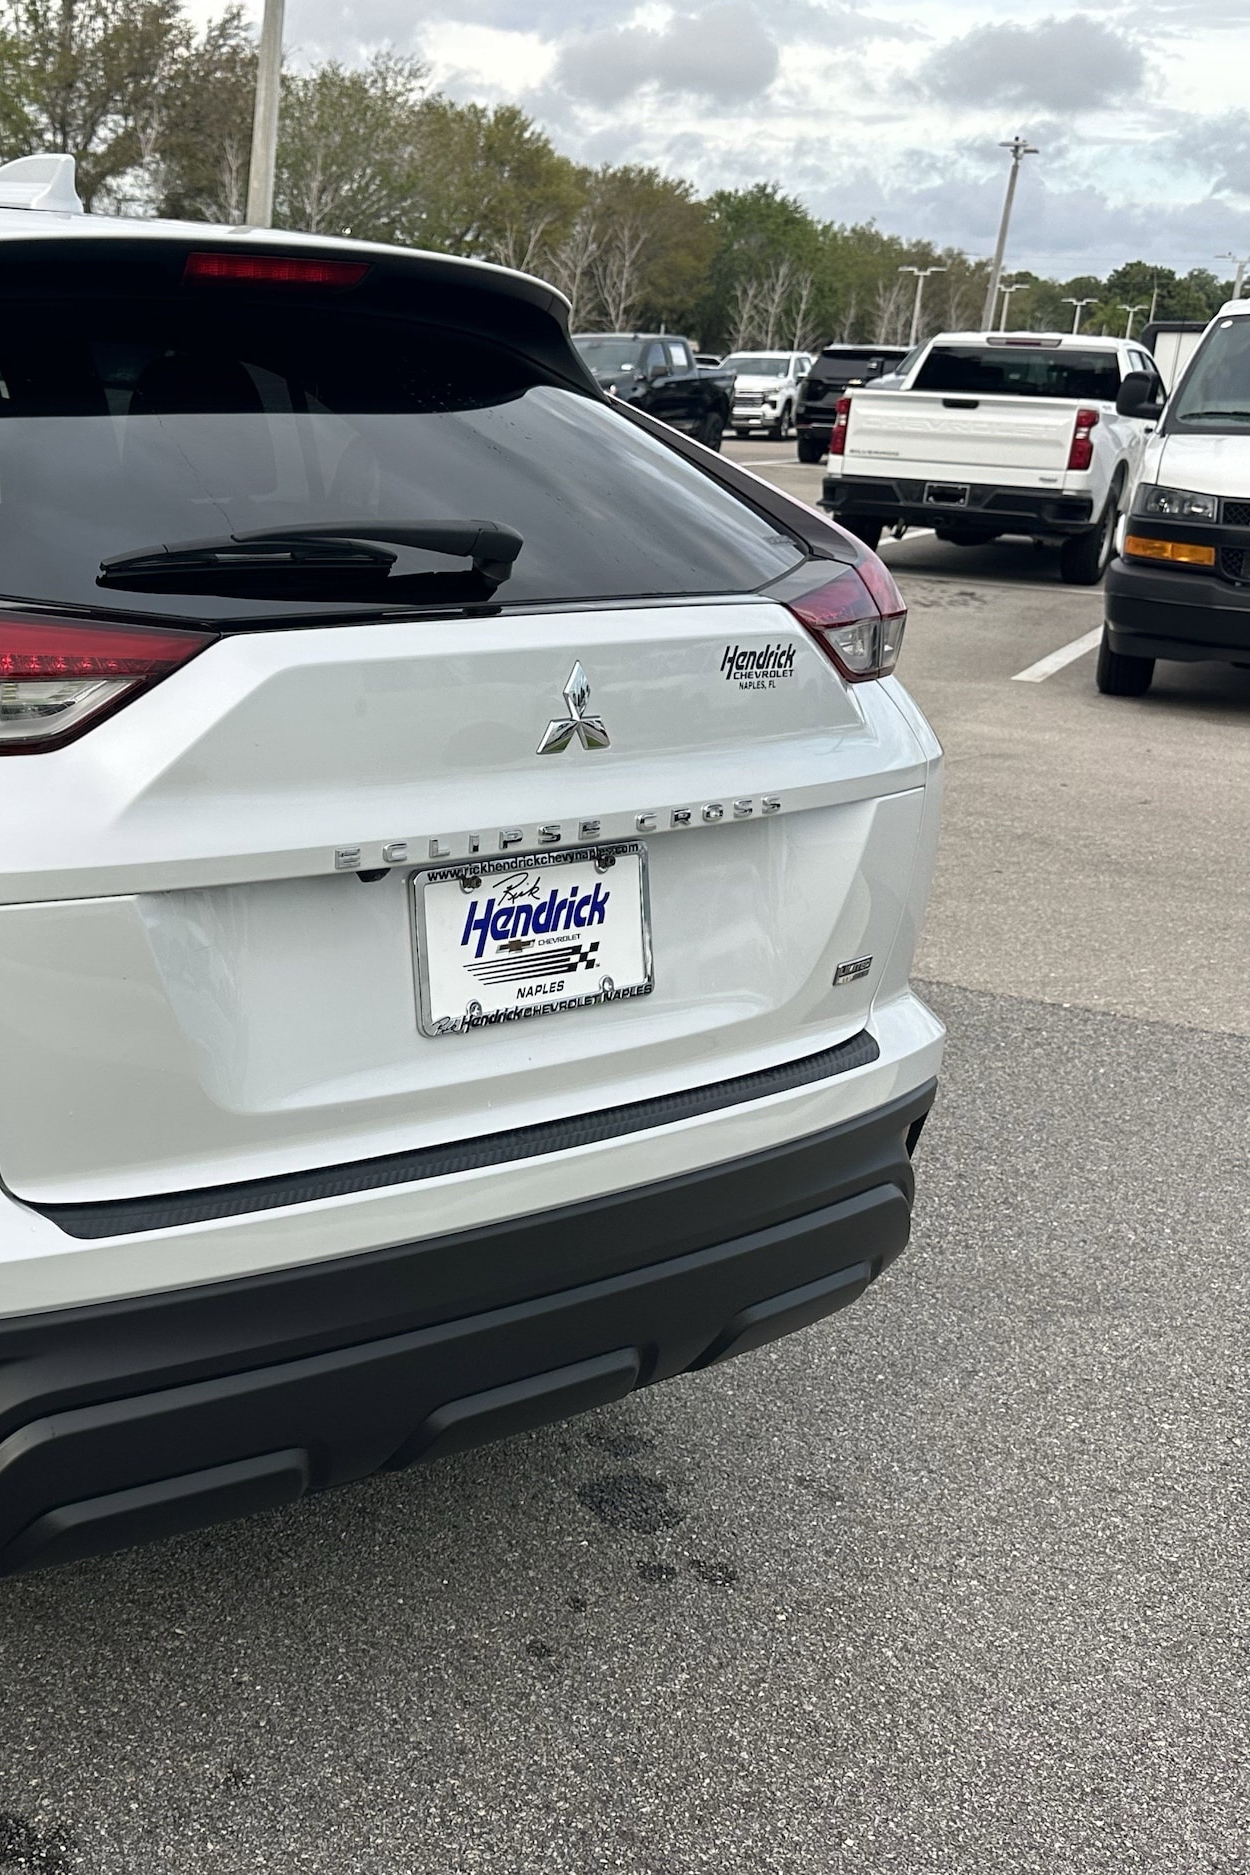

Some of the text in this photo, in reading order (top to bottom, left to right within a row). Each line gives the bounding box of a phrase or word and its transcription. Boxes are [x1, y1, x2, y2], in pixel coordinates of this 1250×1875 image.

[720, 643, 796, 680] Hendrick
[733, 669, 794, 680] CHEVROLET
[738, 680, 777, 690] NAPLES, FL
[334, 793, 782, 870] ECLIPSE CROSS
[492, 872, 541, 906] Rick
[460, 882, 610, 959] Hendrick
[538, 933, 581, 946] CHEVROLET
[516, 980, 565, 999] NAPLES
[459, 1005, 525, 1034] Hendrick
[524, 995, 600, 1018] CHEVROLET
[602, 984, 653, 1003] NAPLES
